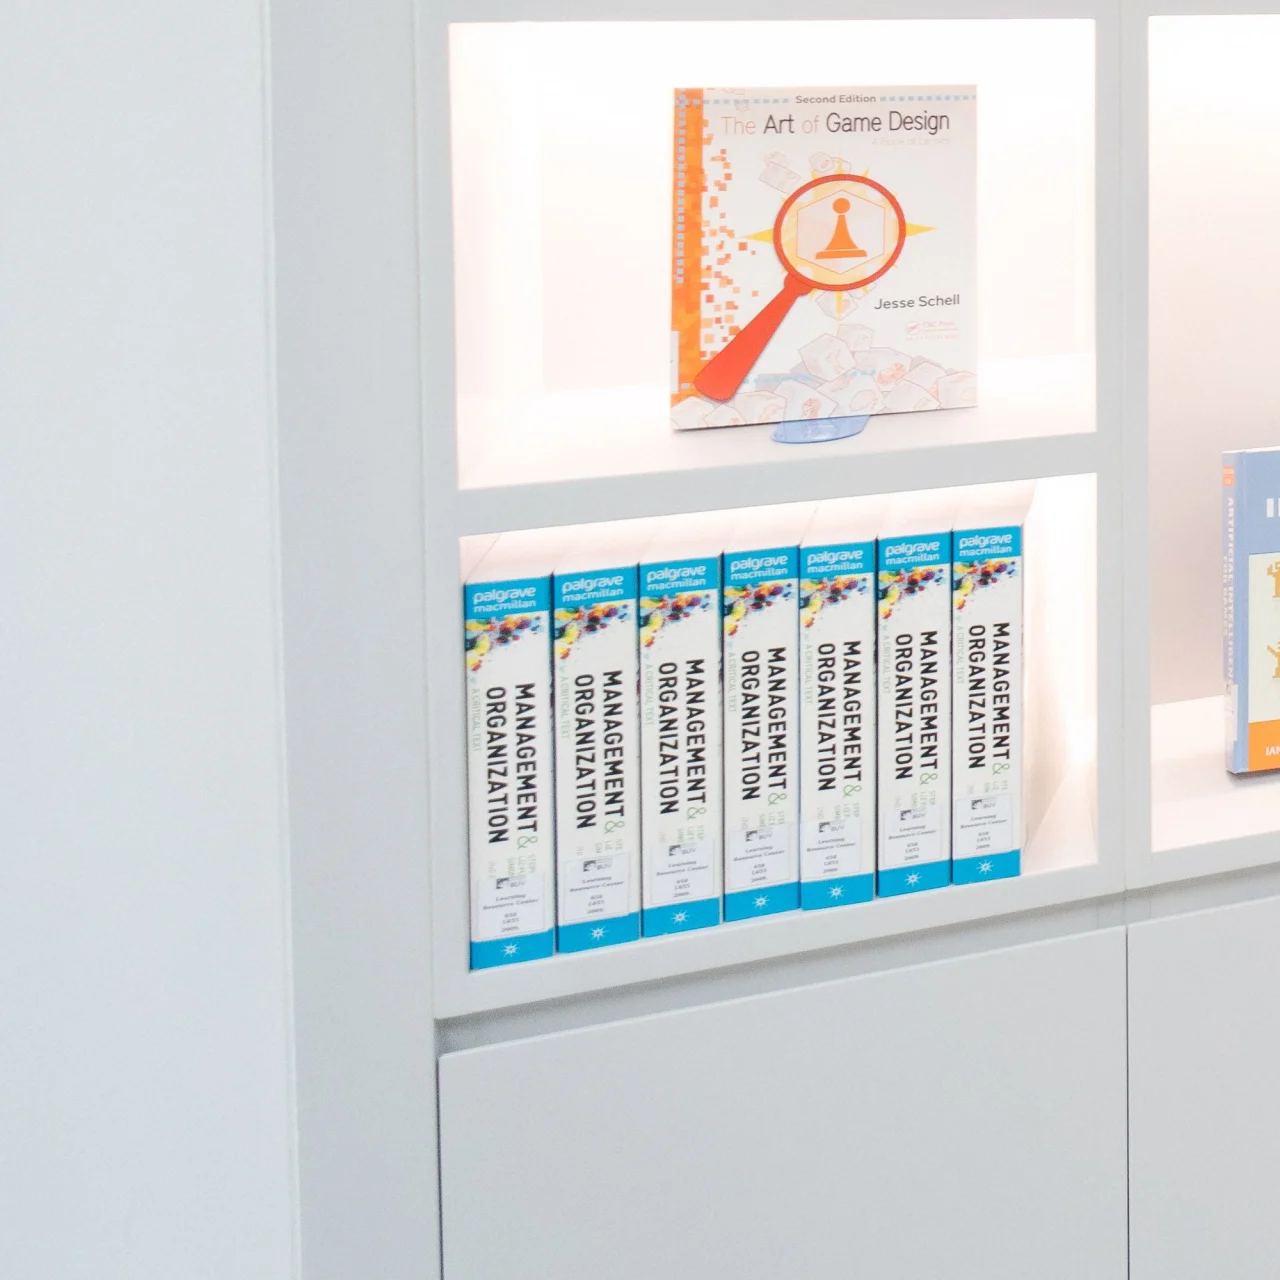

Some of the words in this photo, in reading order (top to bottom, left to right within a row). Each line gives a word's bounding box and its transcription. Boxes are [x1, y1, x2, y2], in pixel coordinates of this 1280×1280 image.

[795, 94, 836, 104] Second
[839, 94, 876, 104] Edition
[721, 116, 756, 135] The
[763, 114, 795, 134] Art
[801, 114, 821, 133] of
[825, 112, 882, 133] Game
[888, 110, 950, 136] Design
[874, 296, 915, 310] Jesse
[919, 294, 960, 307] Schell
[473, 586, 536, 607] palgrave
[473, 599, 536, 613] macmillan
[968, 624, 986, 769] ORGANIZATION
[992, 622, 1010, 761] MANAGEMENT
[485, 687, 509, 845] ORGANIZATION
[515, 683, 538, 833] MANAGEMENT
